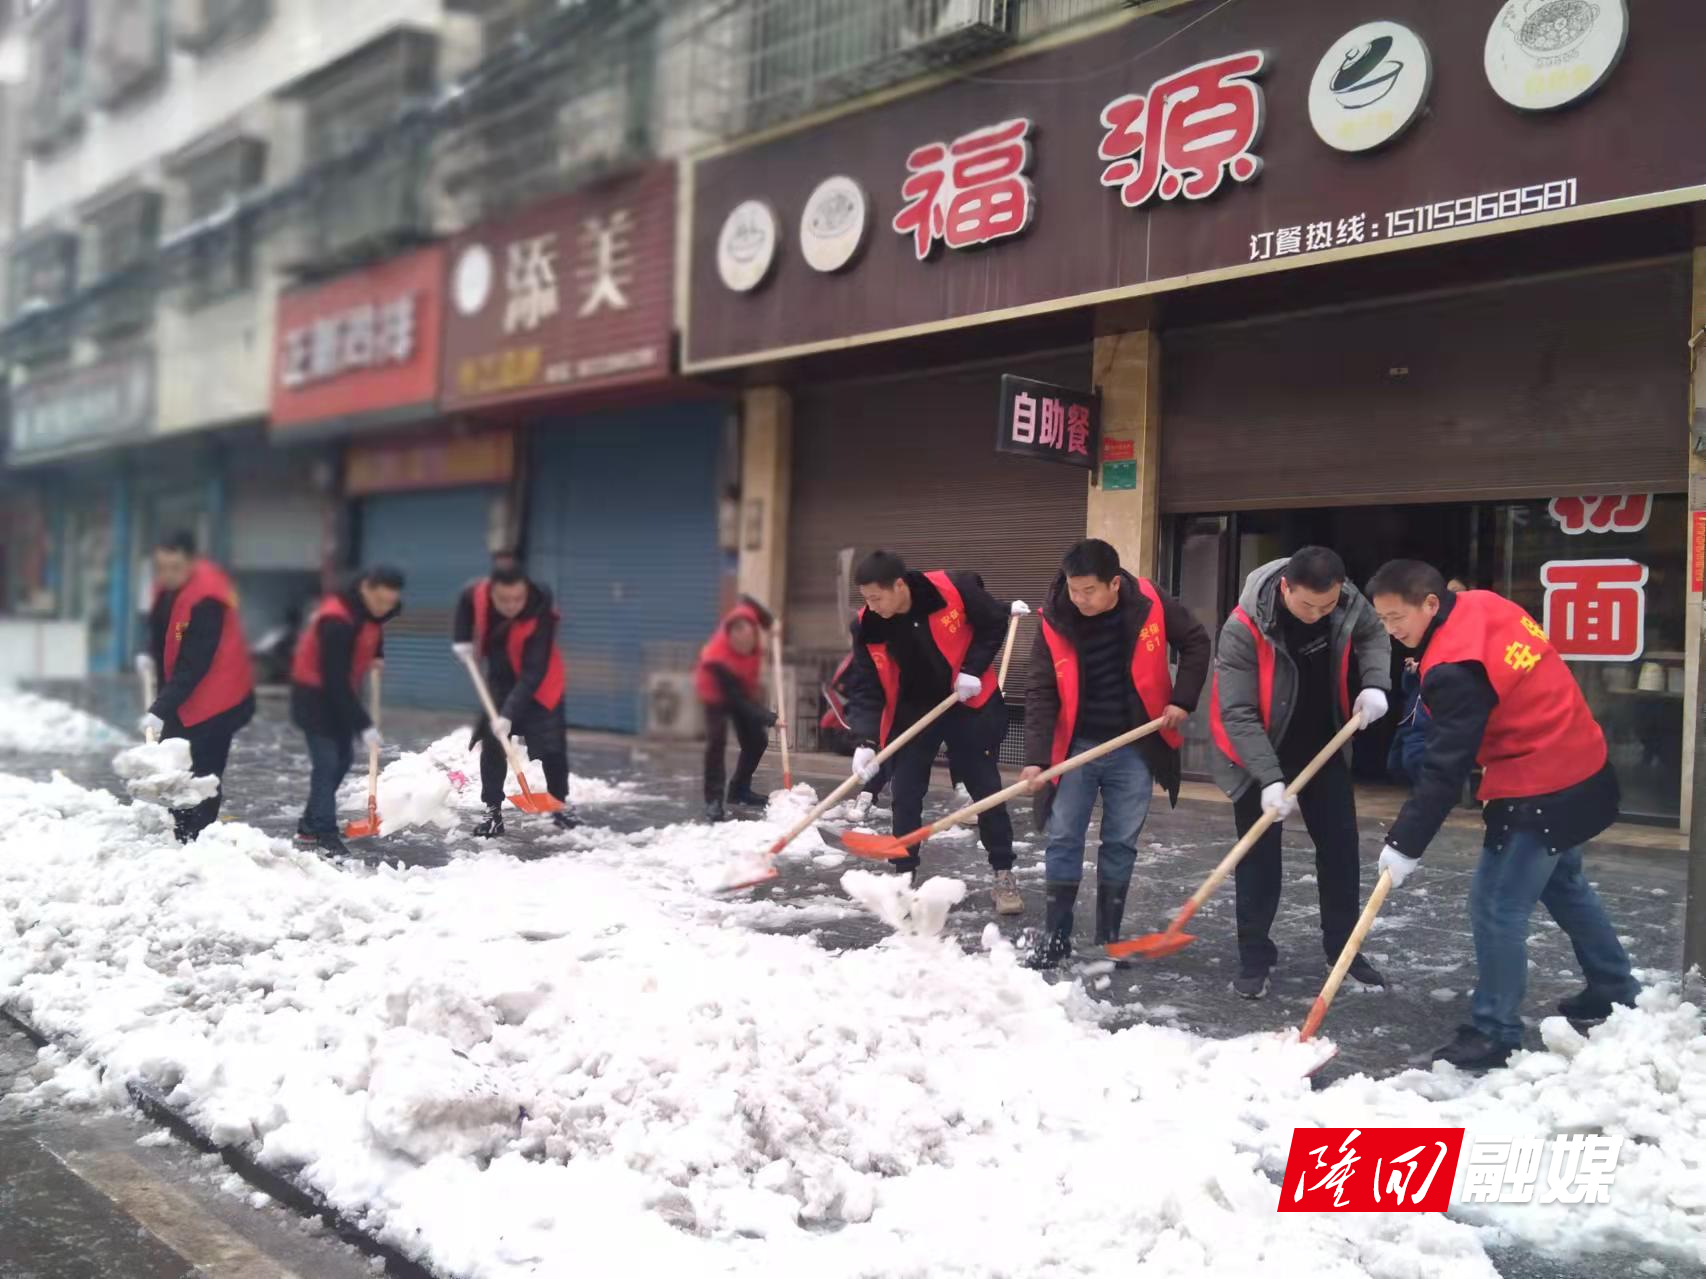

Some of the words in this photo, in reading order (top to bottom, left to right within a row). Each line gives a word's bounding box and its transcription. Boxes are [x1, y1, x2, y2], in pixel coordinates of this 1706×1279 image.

[893, 49, 1265, 261] 福源
[1011, 391, 1090, 456] 自助餐
